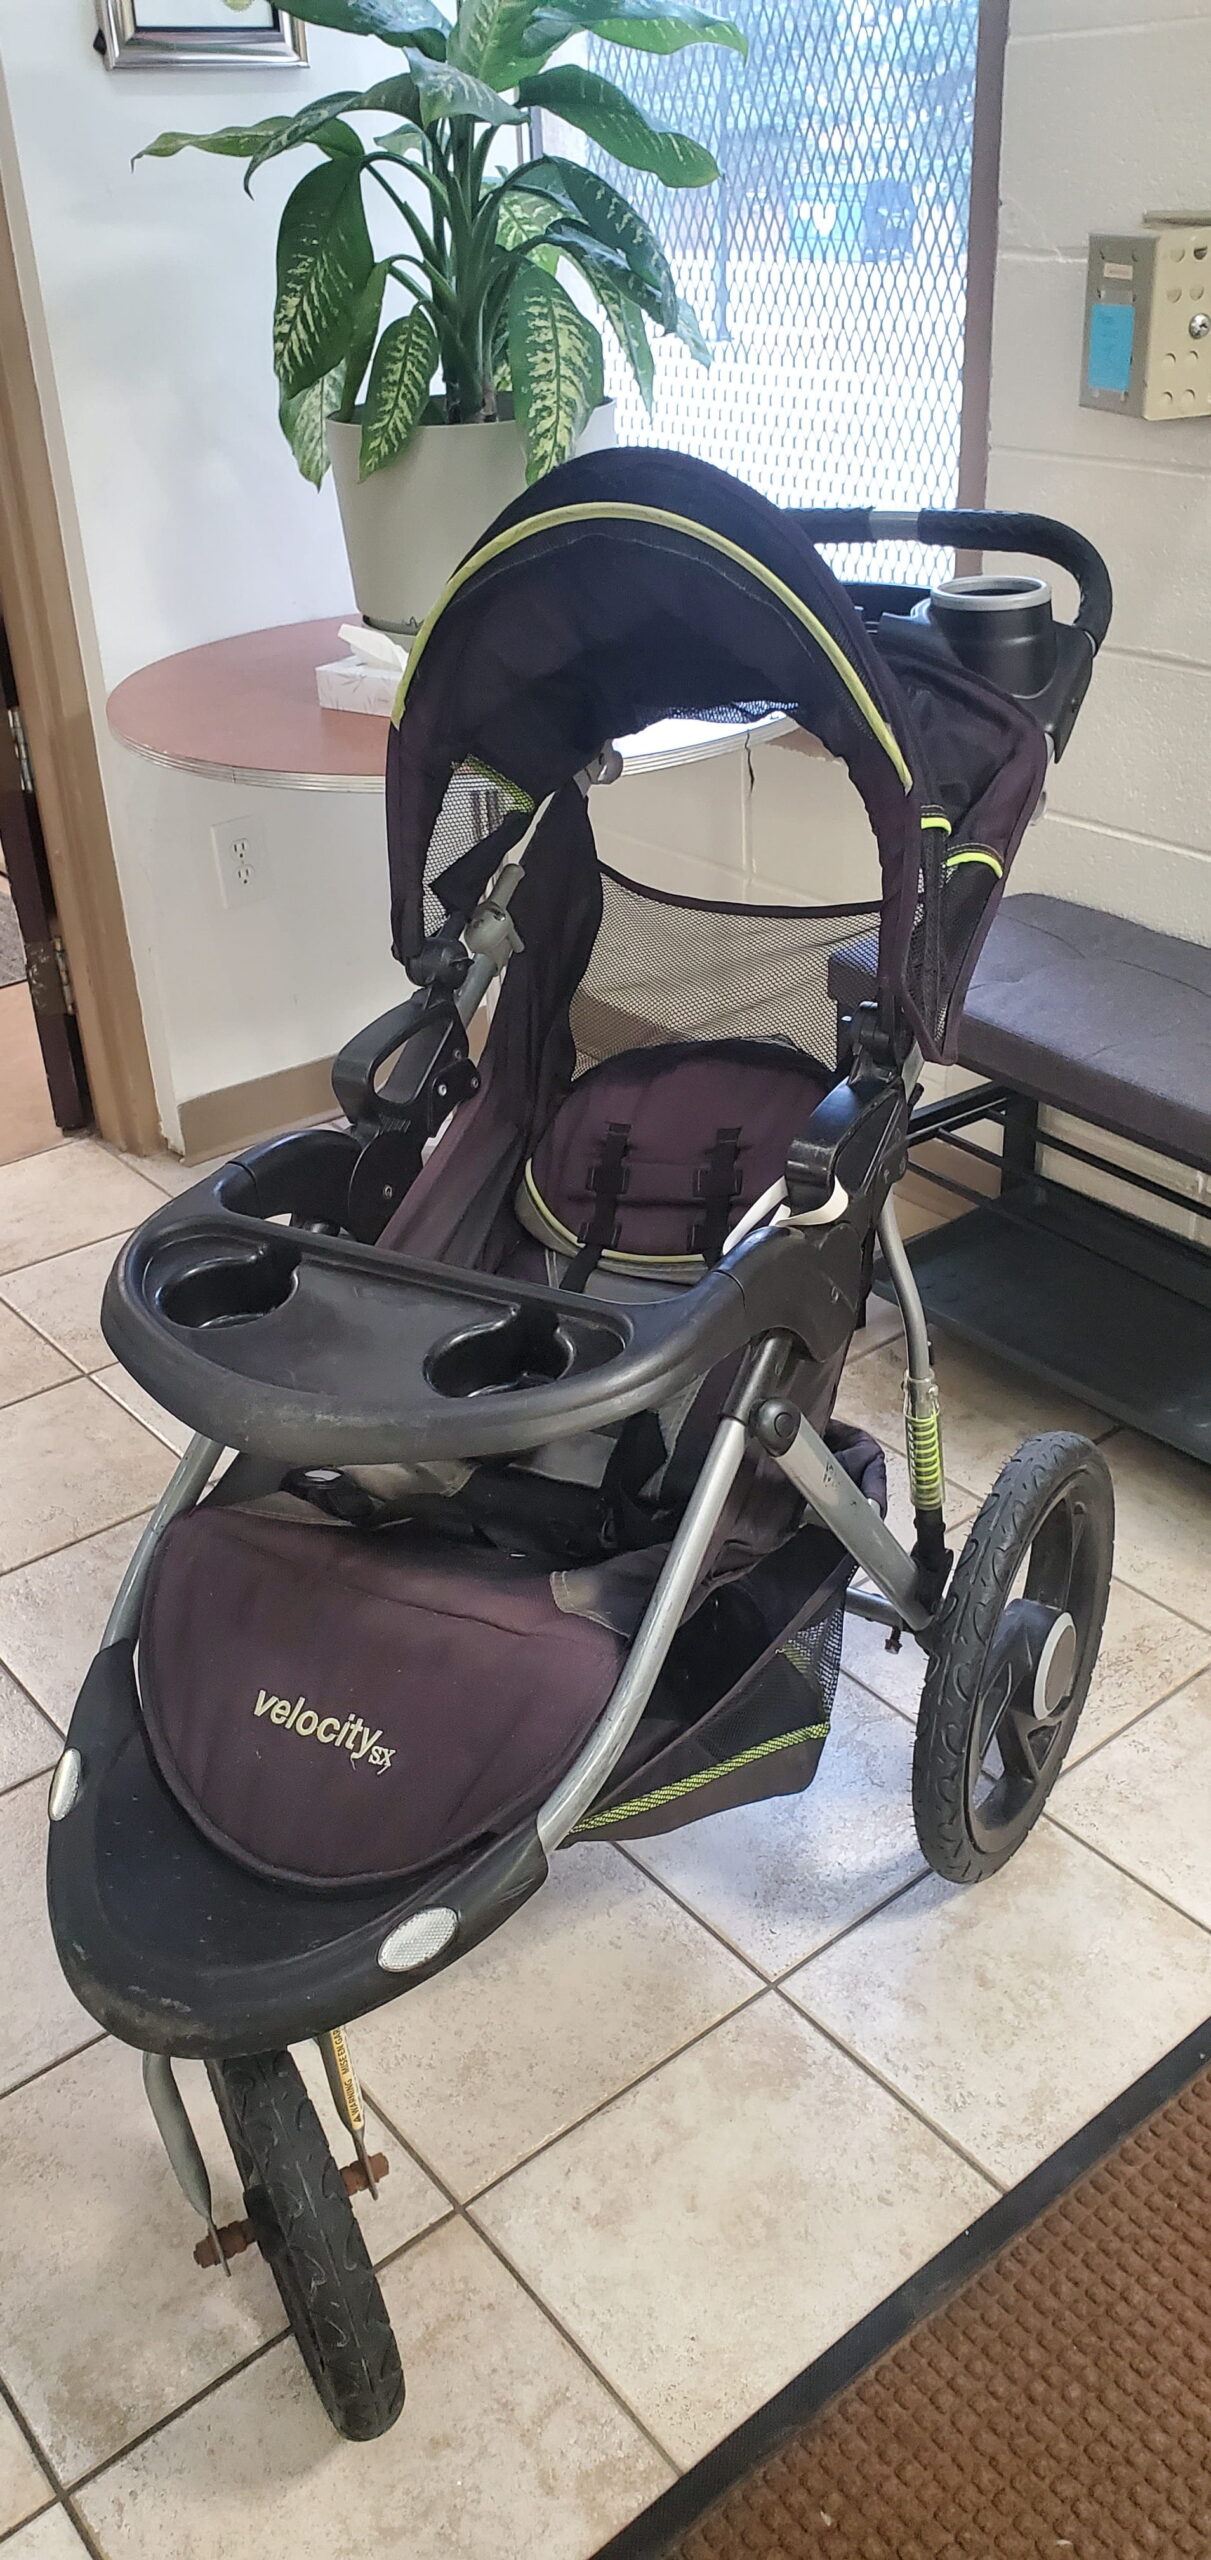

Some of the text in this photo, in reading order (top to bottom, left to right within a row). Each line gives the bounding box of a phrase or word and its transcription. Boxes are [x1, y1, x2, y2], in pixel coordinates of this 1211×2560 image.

[253, 1689, 384, 1760] velocity
[335, 2043, 346, 2057] EN
[338, 2055, 350, 2075] MISE
[344, 2078, 360, 2116] WARNING
